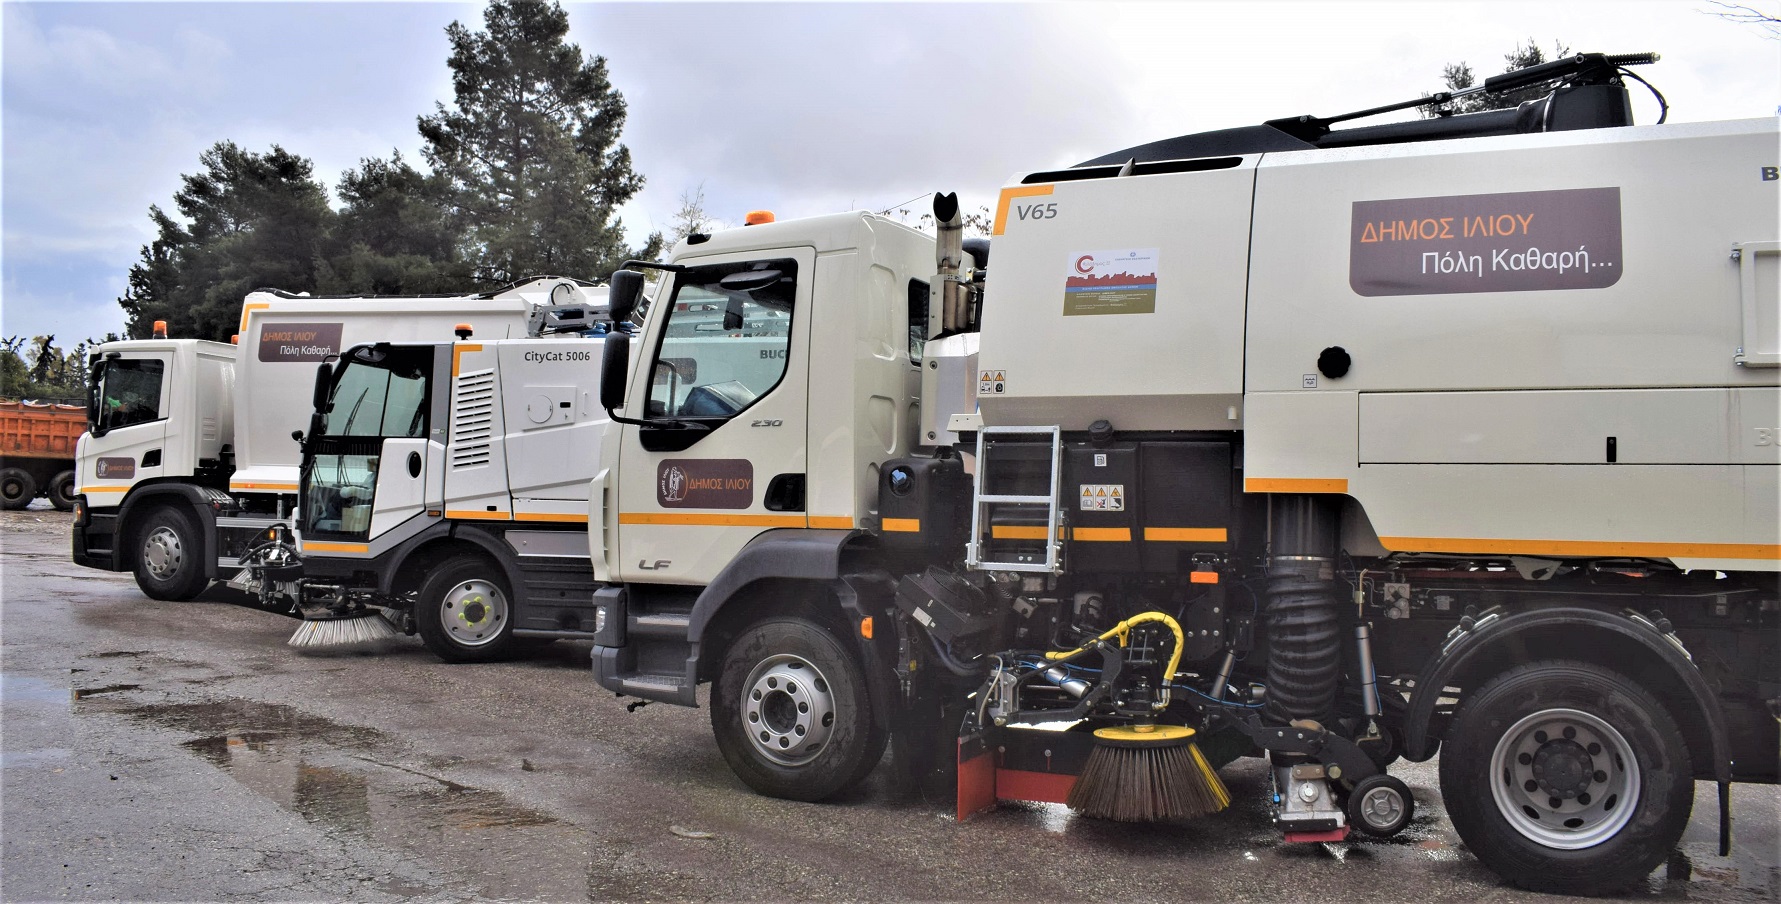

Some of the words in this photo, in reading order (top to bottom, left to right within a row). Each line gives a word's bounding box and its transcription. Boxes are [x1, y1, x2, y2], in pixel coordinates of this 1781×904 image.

[1761, 166, 1780, 181] B
[1017, 202, 1058, 221] V65
[1360, 217, 1455, 243] ΔΗΜΟΣ
[1463, 213, 1535, 238] ΙΛΙΟΥ
[1421, 250, 1483, 278] Πόλη
[1492, 245, 1613, 274] Καθαρή...
[262, 331, 293, 342] ΔΗΜΟΣ
[293, 331, 318, 342] ΙΛΙΟΥ
[280, 345, 300, 357] Πόλη
[524, 350, 563, 364] CityCat
[565, 351, 591, 362] 5006
[759, 349, 787, 360] BUC
[750, 419, 784, 428] 230
[688, 478, 723, 491] ΔΗΜΟΣ
[725, 478, 752, 491] ΙΛΙΟΥ
[638, 559, 672, 571] LF
